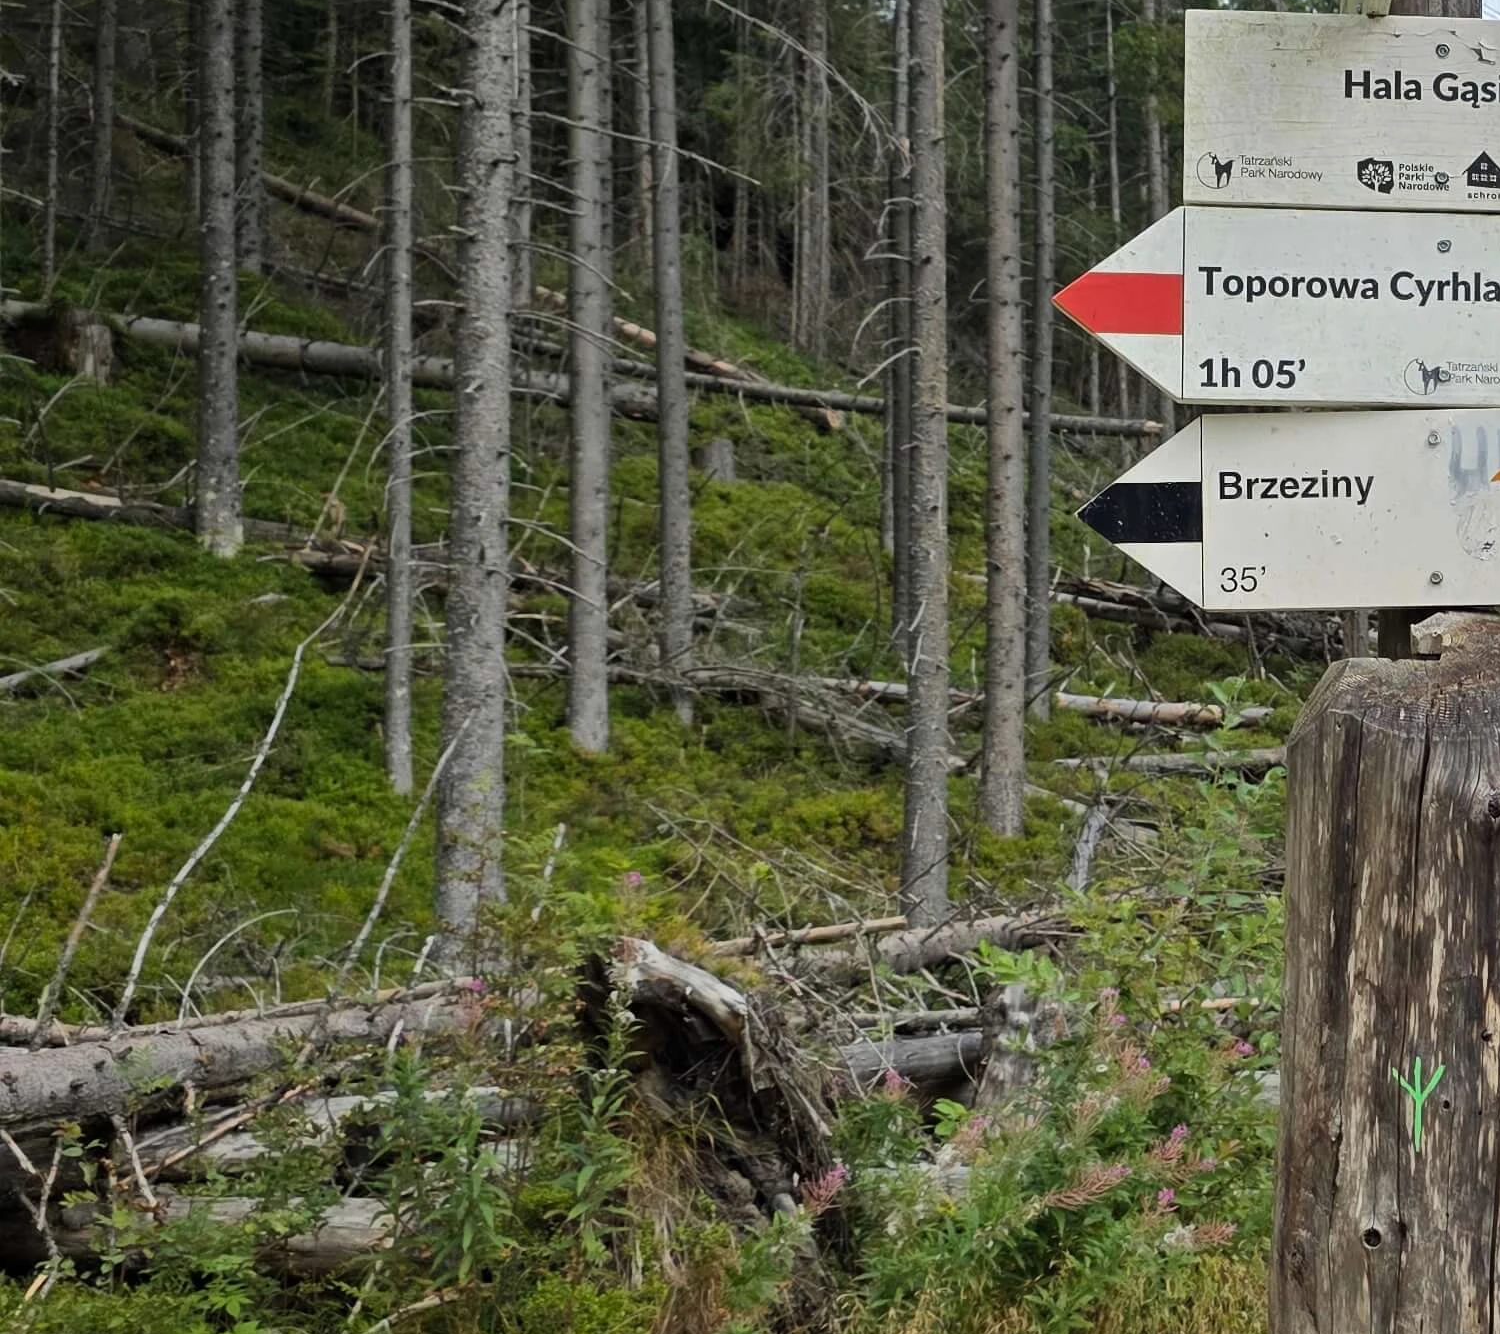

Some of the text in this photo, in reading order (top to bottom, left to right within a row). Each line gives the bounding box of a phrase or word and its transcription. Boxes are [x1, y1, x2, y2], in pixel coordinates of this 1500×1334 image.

[1344, 69, 1422, 100] Hala
[1239, 154, 1292, 167] Tatrzański
[1240, 168, 1323, 181] Park Narodowy
[1399, 163, 1434, 173] Polskie
[1399, 173, 1425, 182] Parki
[1398, 182, 1450, 192] Narodowe
[1198, 266, 1380, 303] Toporowa
[1199, 358, 1241, 388] 1h
[1446, 361, 1498, 372] Tatrzański
[1449, 374, 1473, 384] Park
[1219, 469, 1374, 505] Brzeziny
